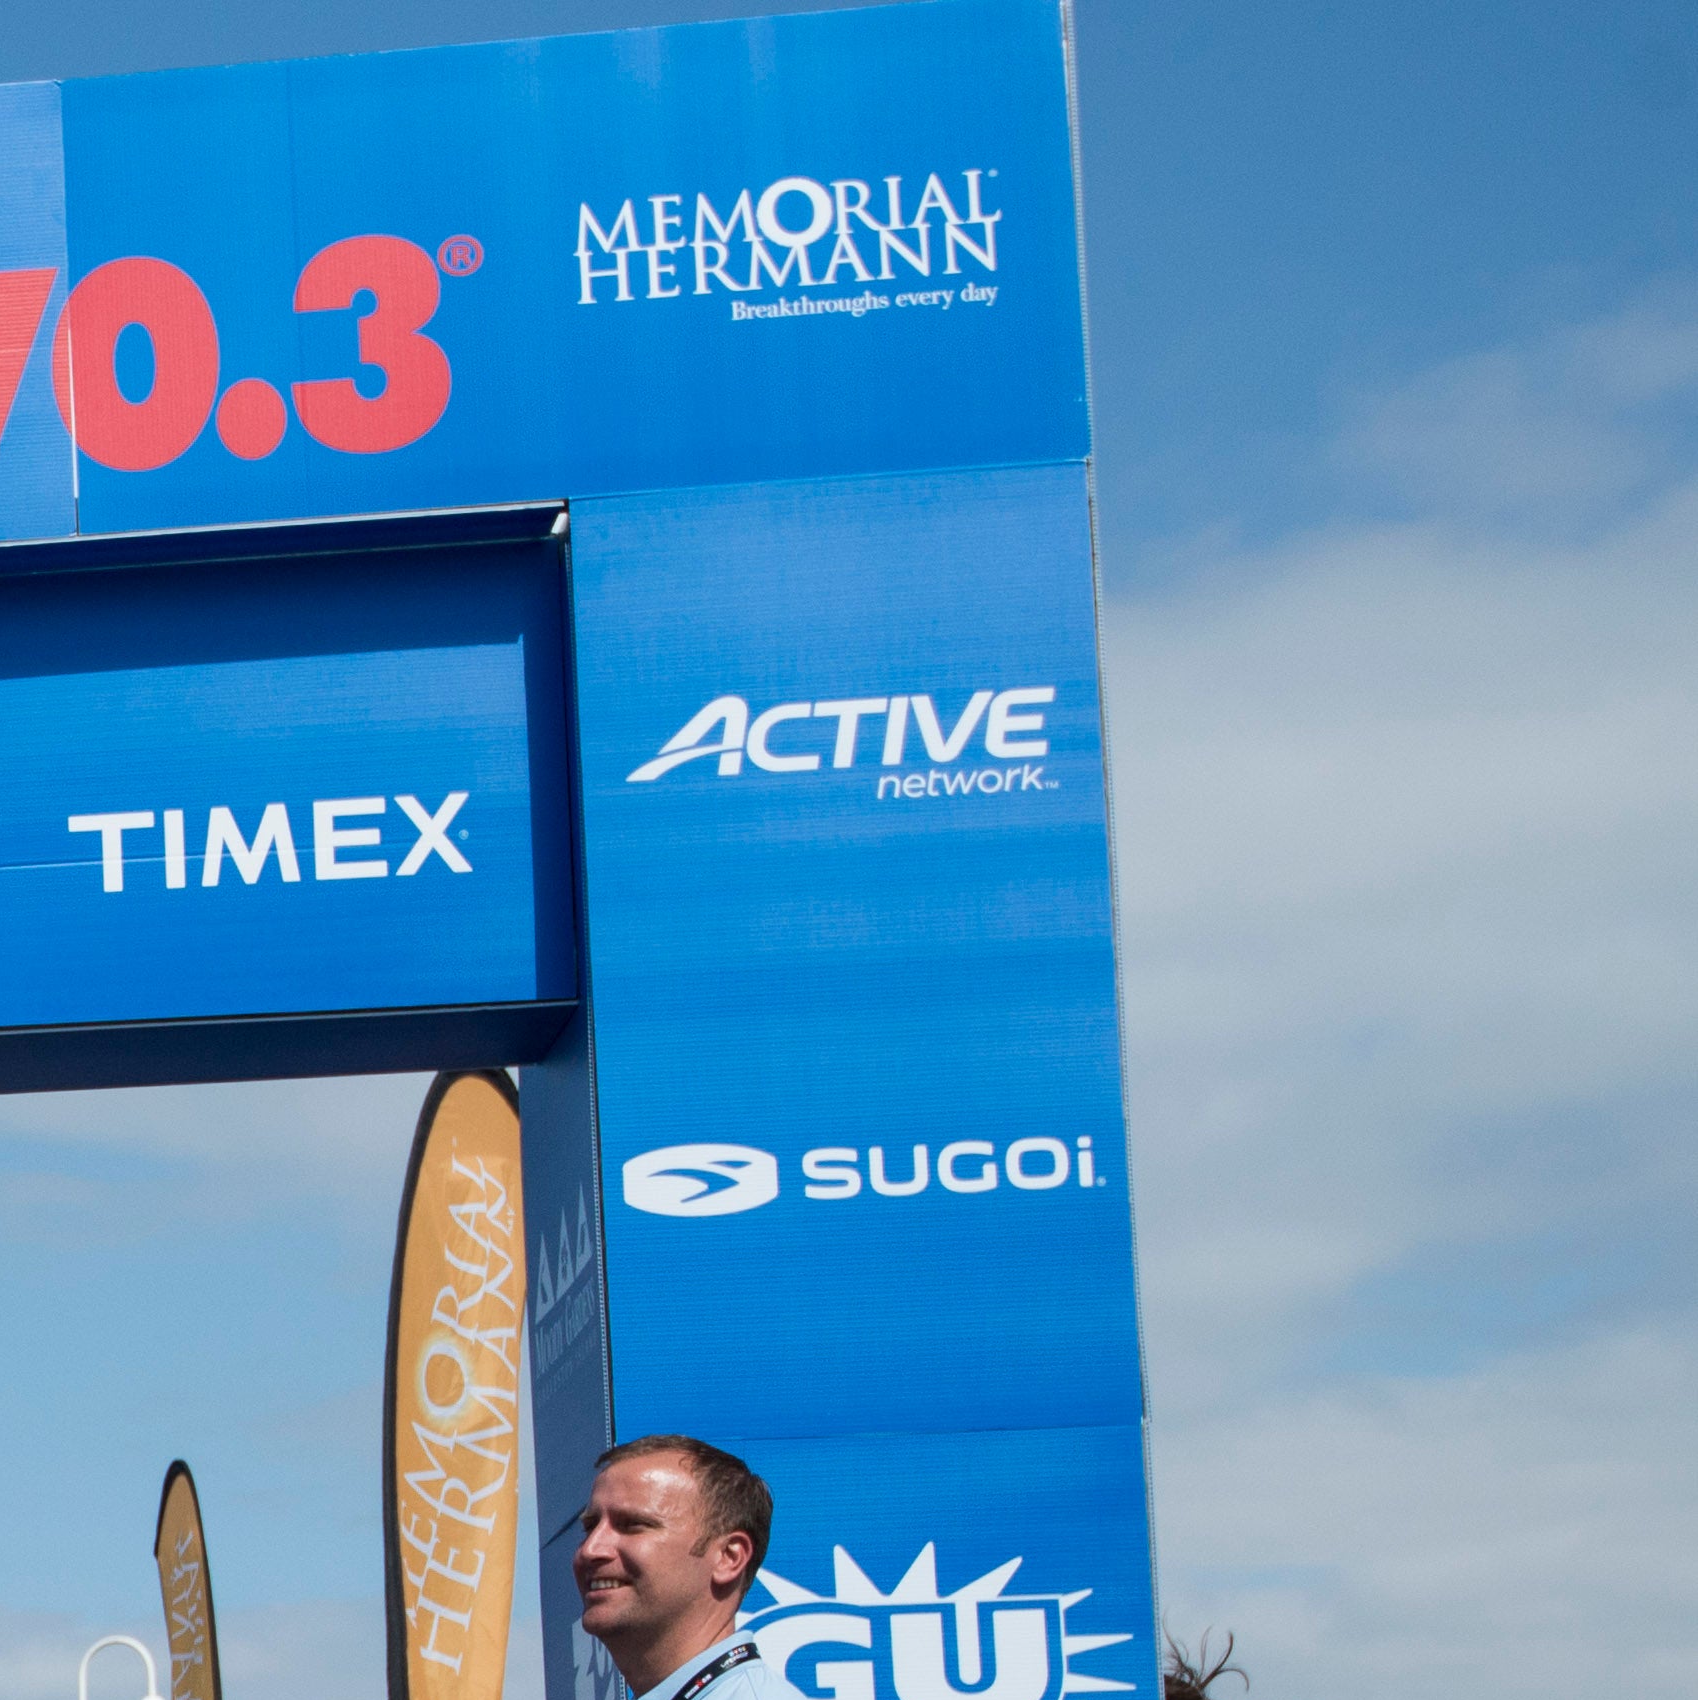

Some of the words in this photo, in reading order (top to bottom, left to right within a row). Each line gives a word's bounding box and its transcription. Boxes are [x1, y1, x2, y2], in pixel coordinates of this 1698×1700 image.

[573, 168, 1002, 257] MEMORIAL
[577, 221, 1001, 305] HERMANN
[731, 290, 890, 321] Breakthroughs
[895, 288, 954, 310] every
[960, 283, 999, 306] day
[627, 686, 1056, 782] ACTIVE
[876, 766, 1049, 800] network
[67, 791, 472, 896] TIMEX
[419, 1170, 518, 1677] HERMANN
